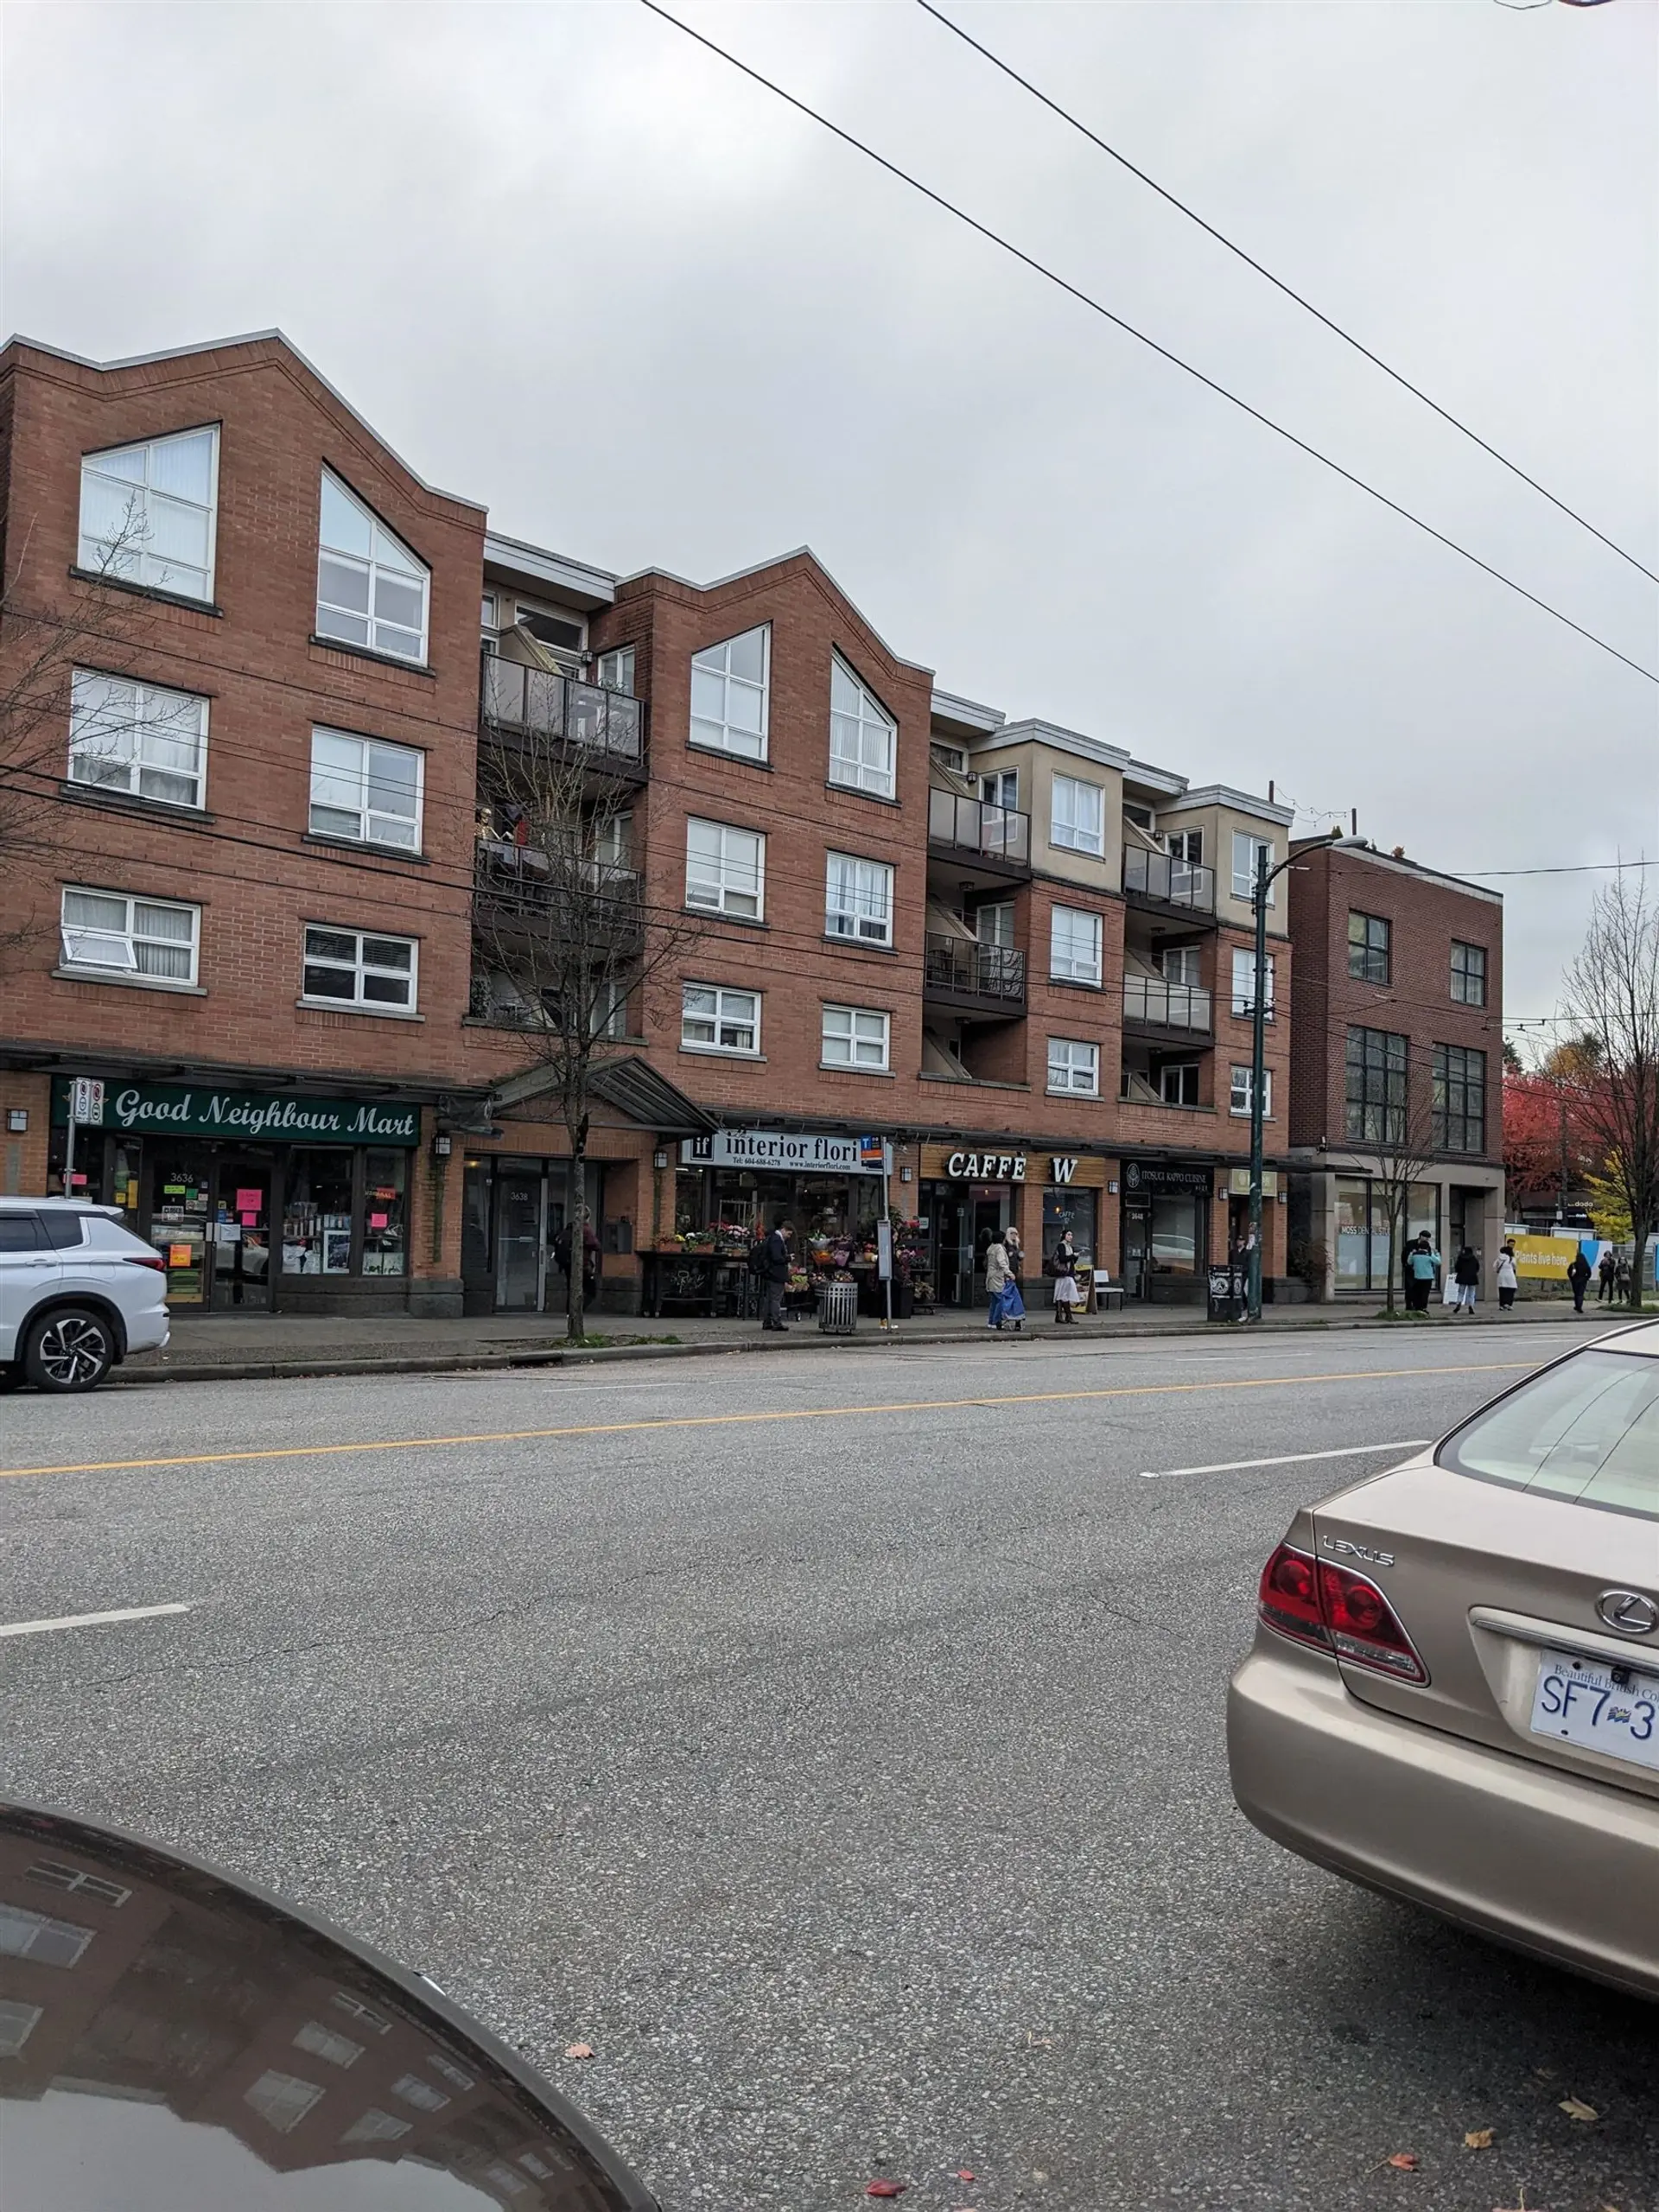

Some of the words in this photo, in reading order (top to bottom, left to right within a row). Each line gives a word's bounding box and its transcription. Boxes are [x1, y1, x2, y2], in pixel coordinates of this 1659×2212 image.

[116, 1090, 192, 1127] Good
[199, 1096, 340, 1134] Neighbour
[346, 1107, 414, 1135] Mart
[696, 1137, 709, 1154] if
[726, 1131, 808, 1159] interior
[814, 1137, 857, 1162] flori
[790, 1160, 851, 1171] www.interiorflori.com
[1052, 1157, 1077, 1183] W
[170, 1173, 194, 1183] 3636
[1342, 1226, 1357, 1235] MOSS
[1516, 1250, 1537, 1262] Plants
[1538, 1252, 1550, 1264] live
[1323, 1535, 1395, 1567] LEXUS
[1555, 1664, 1603, 1688] Beautiful
[1541, 1675, 1611, 1726] SF7
[1630, 1700, 1656, 1740] 3
